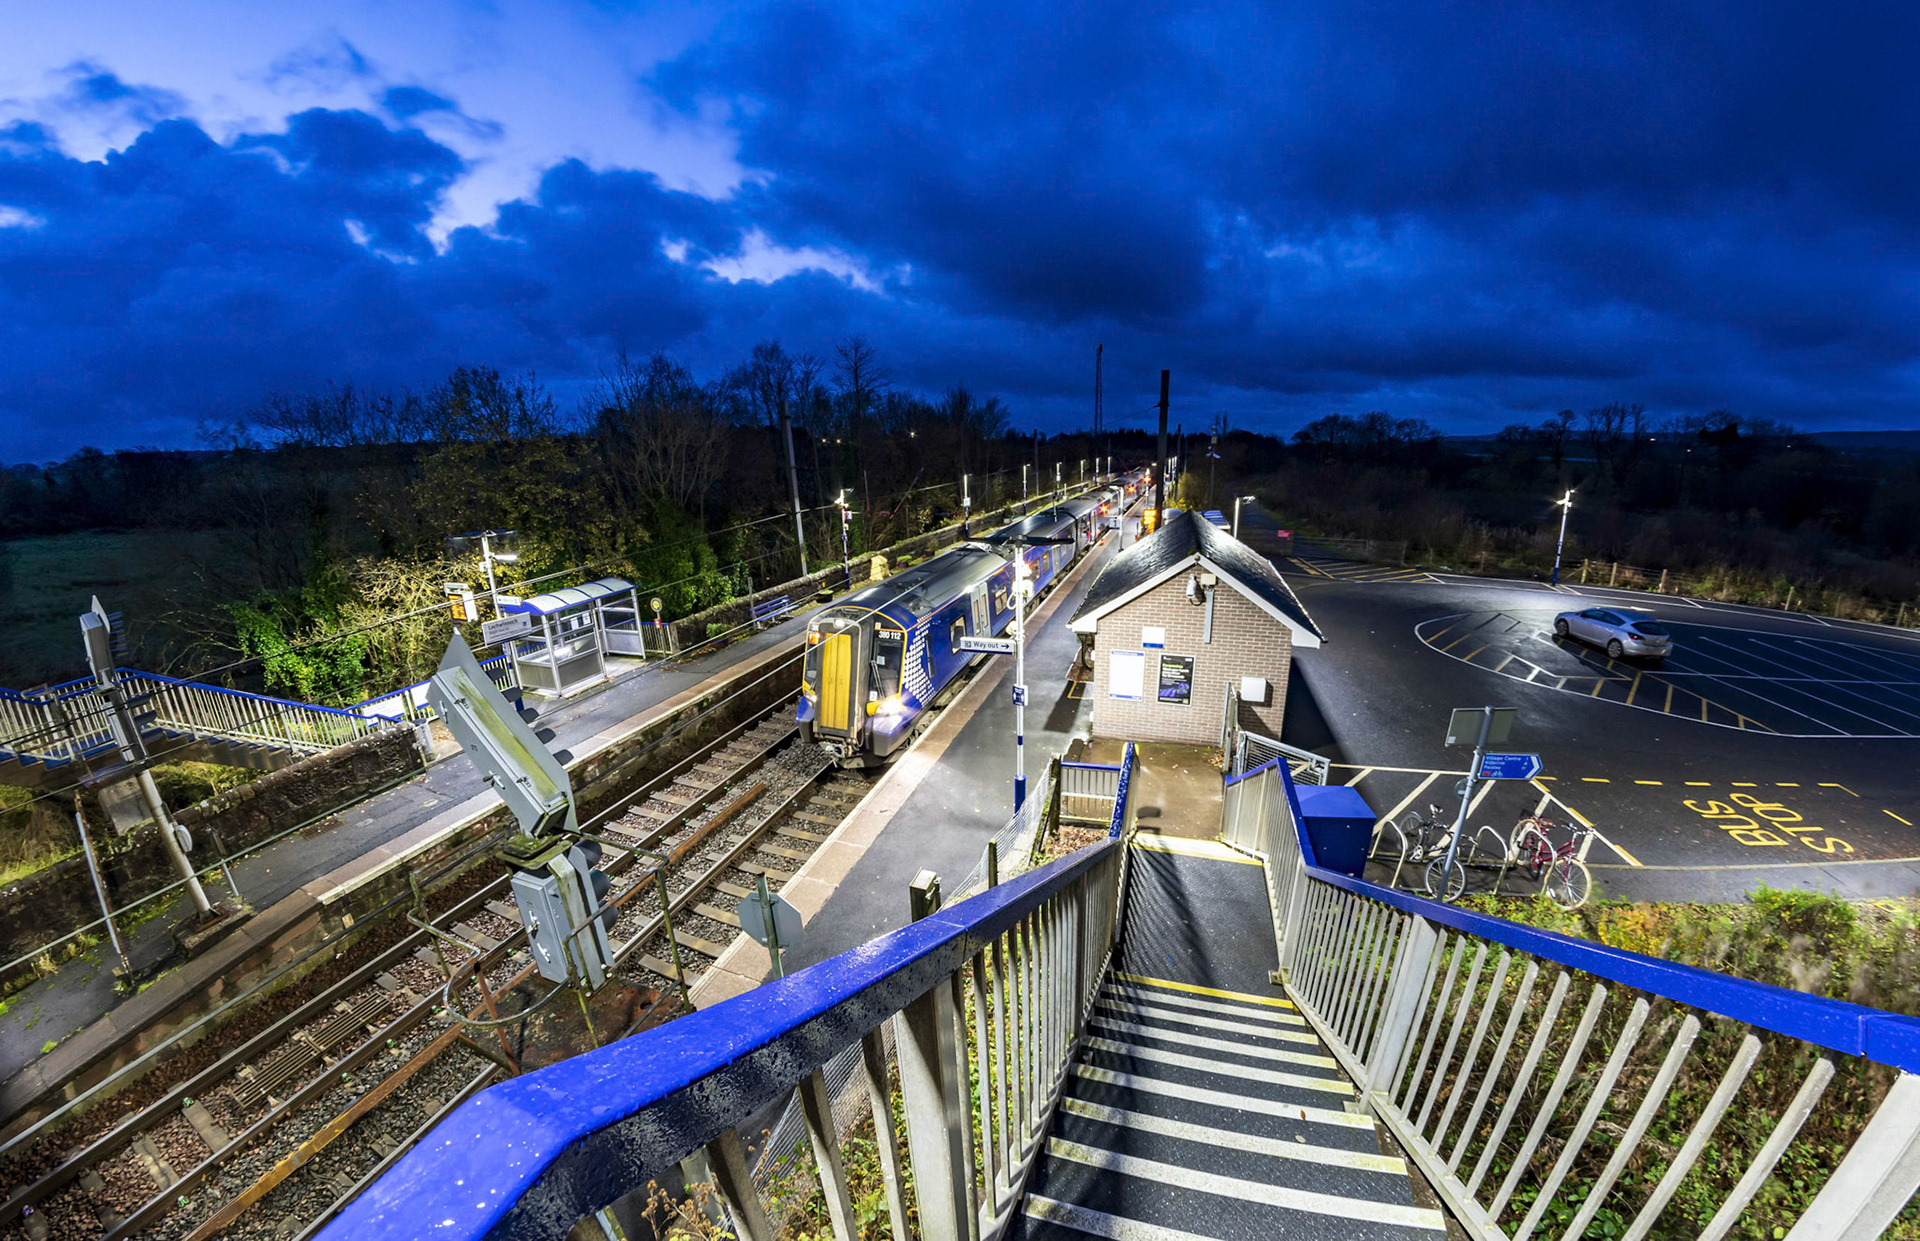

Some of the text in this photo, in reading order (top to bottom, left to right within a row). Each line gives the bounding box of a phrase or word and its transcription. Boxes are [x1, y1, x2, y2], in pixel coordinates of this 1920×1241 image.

[878, 631, 901, 640] 380 112
[1683, 800, 1789, 846] BUS
[1729, 793, 1855, 853] STOP
